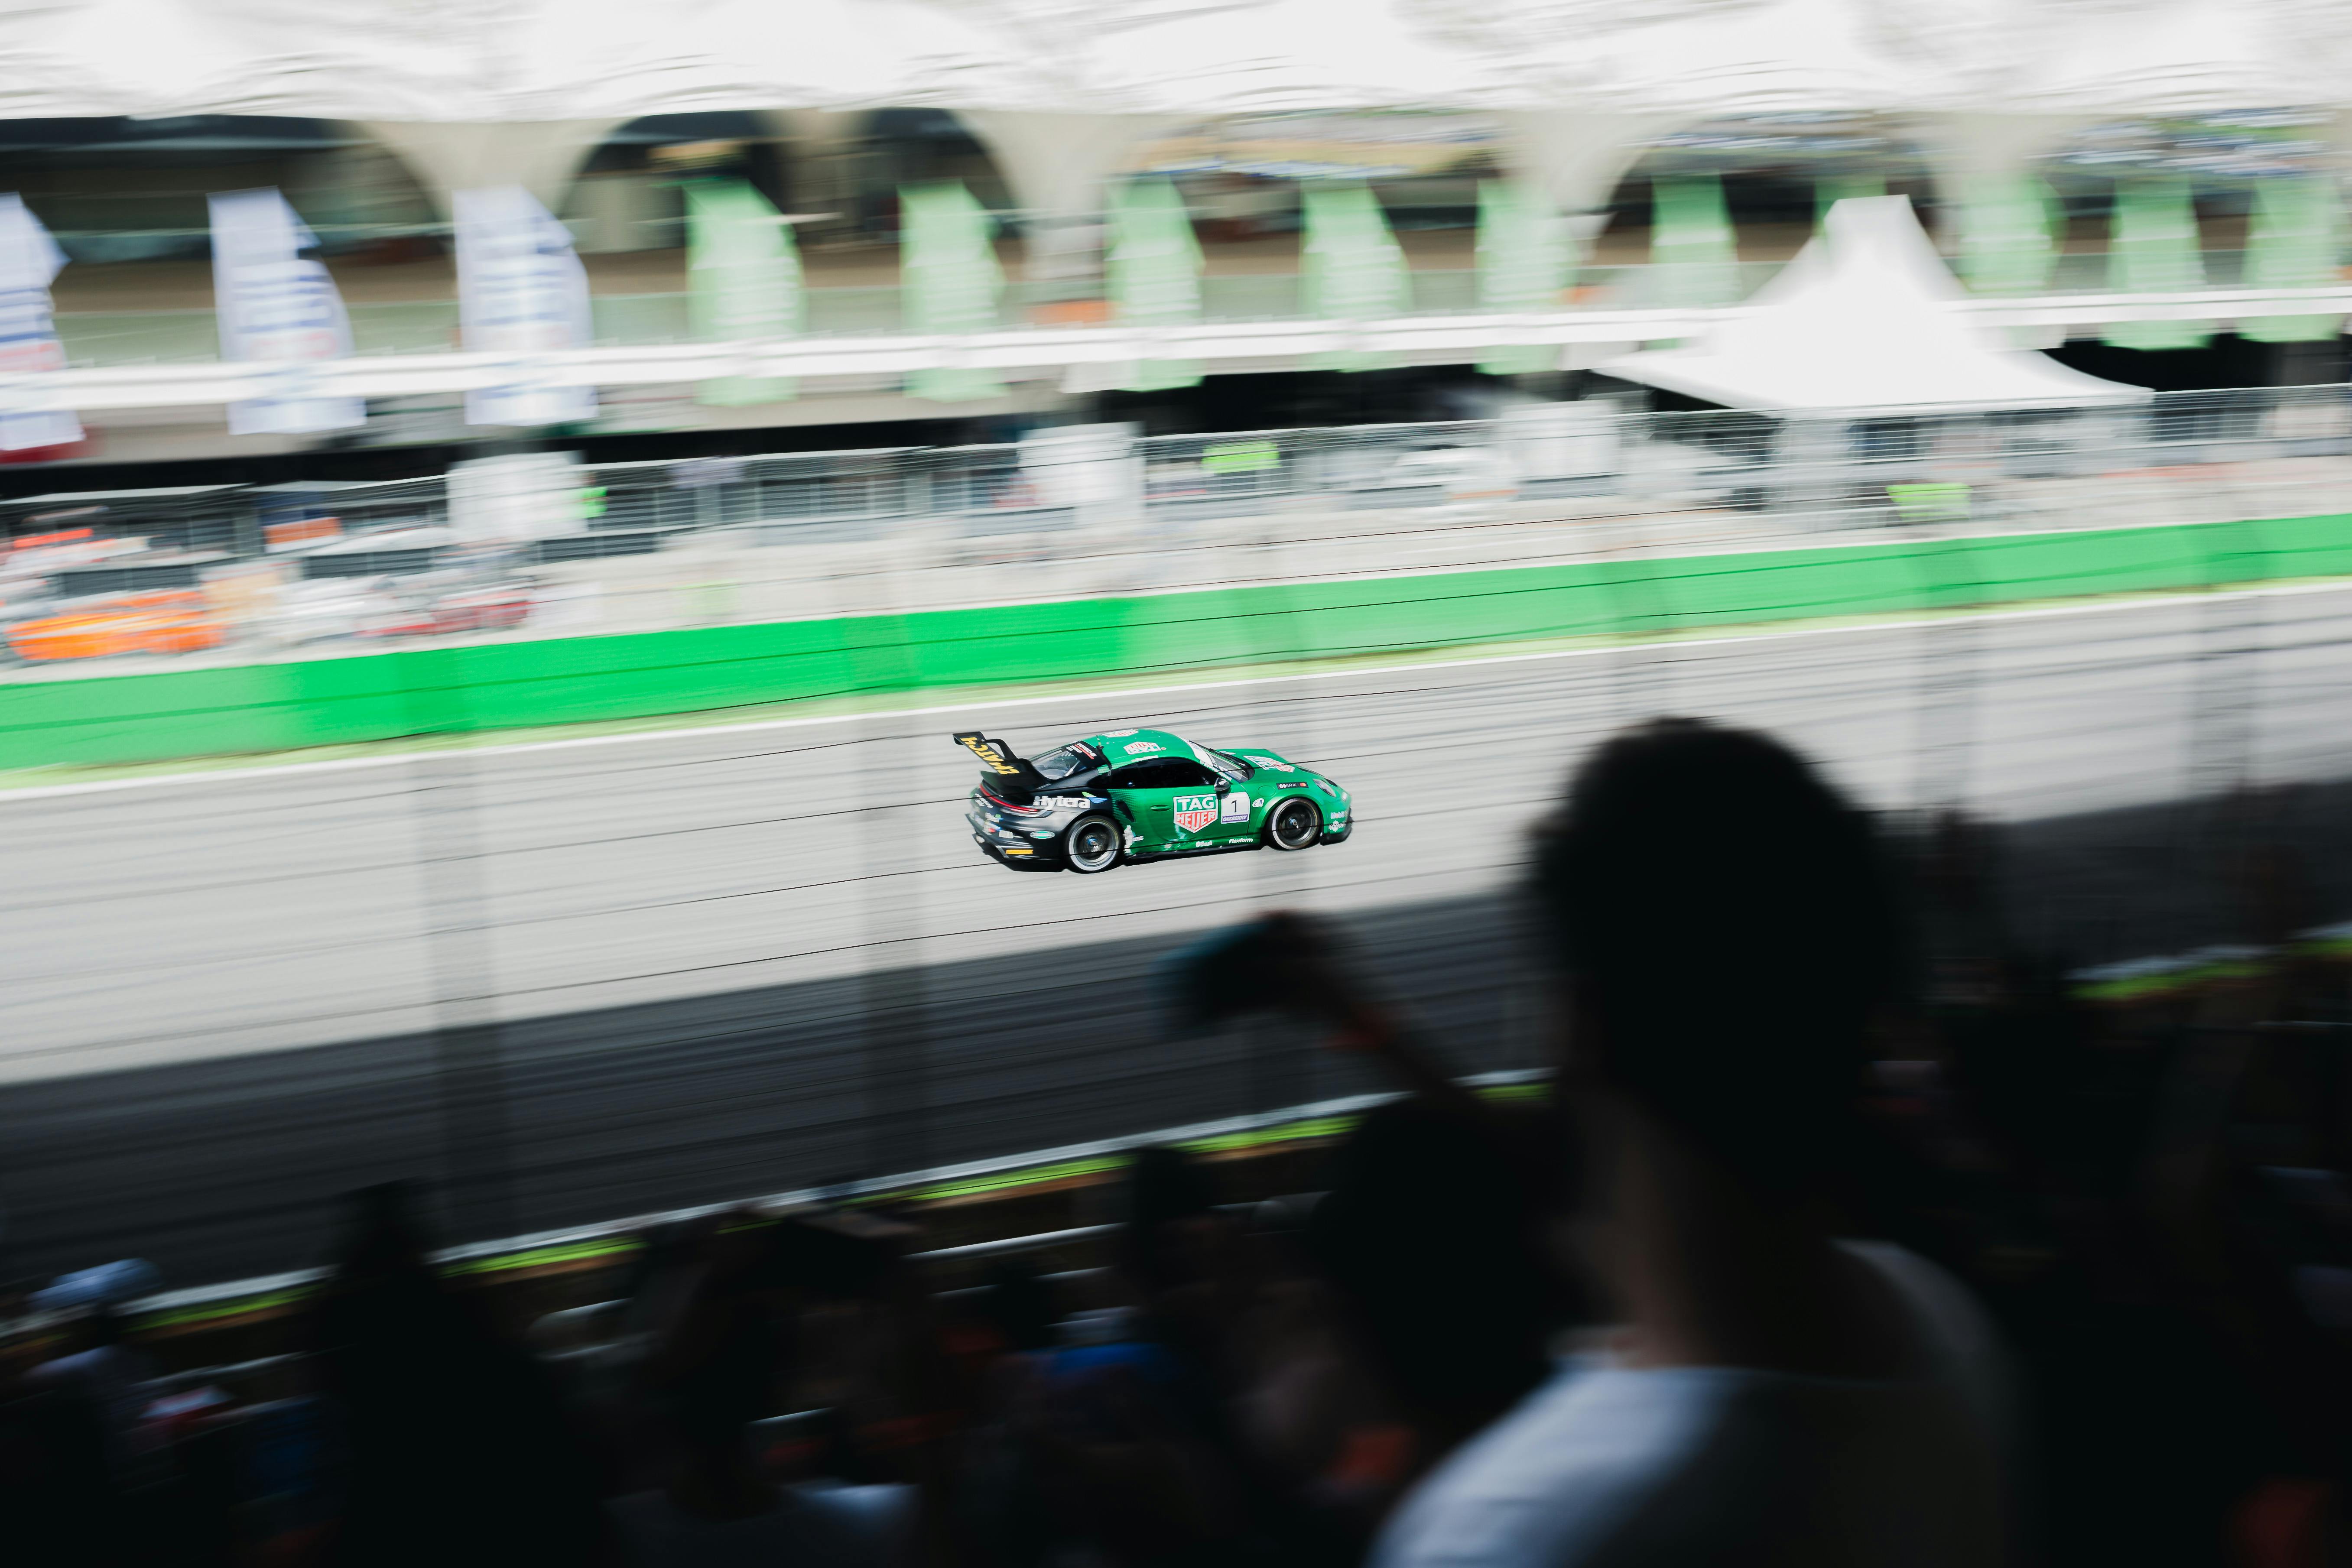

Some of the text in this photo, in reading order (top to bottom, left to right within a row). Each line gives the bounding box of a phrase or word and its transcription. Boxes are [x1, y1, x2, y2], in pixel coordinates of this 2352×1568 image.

[1033, 796, 1091, 810] Hytera
[1177, 797, 1214, 811] TAG
[1231, 800, 1237, 813] 1
[1176, 811, 1215, 829] HEUER
